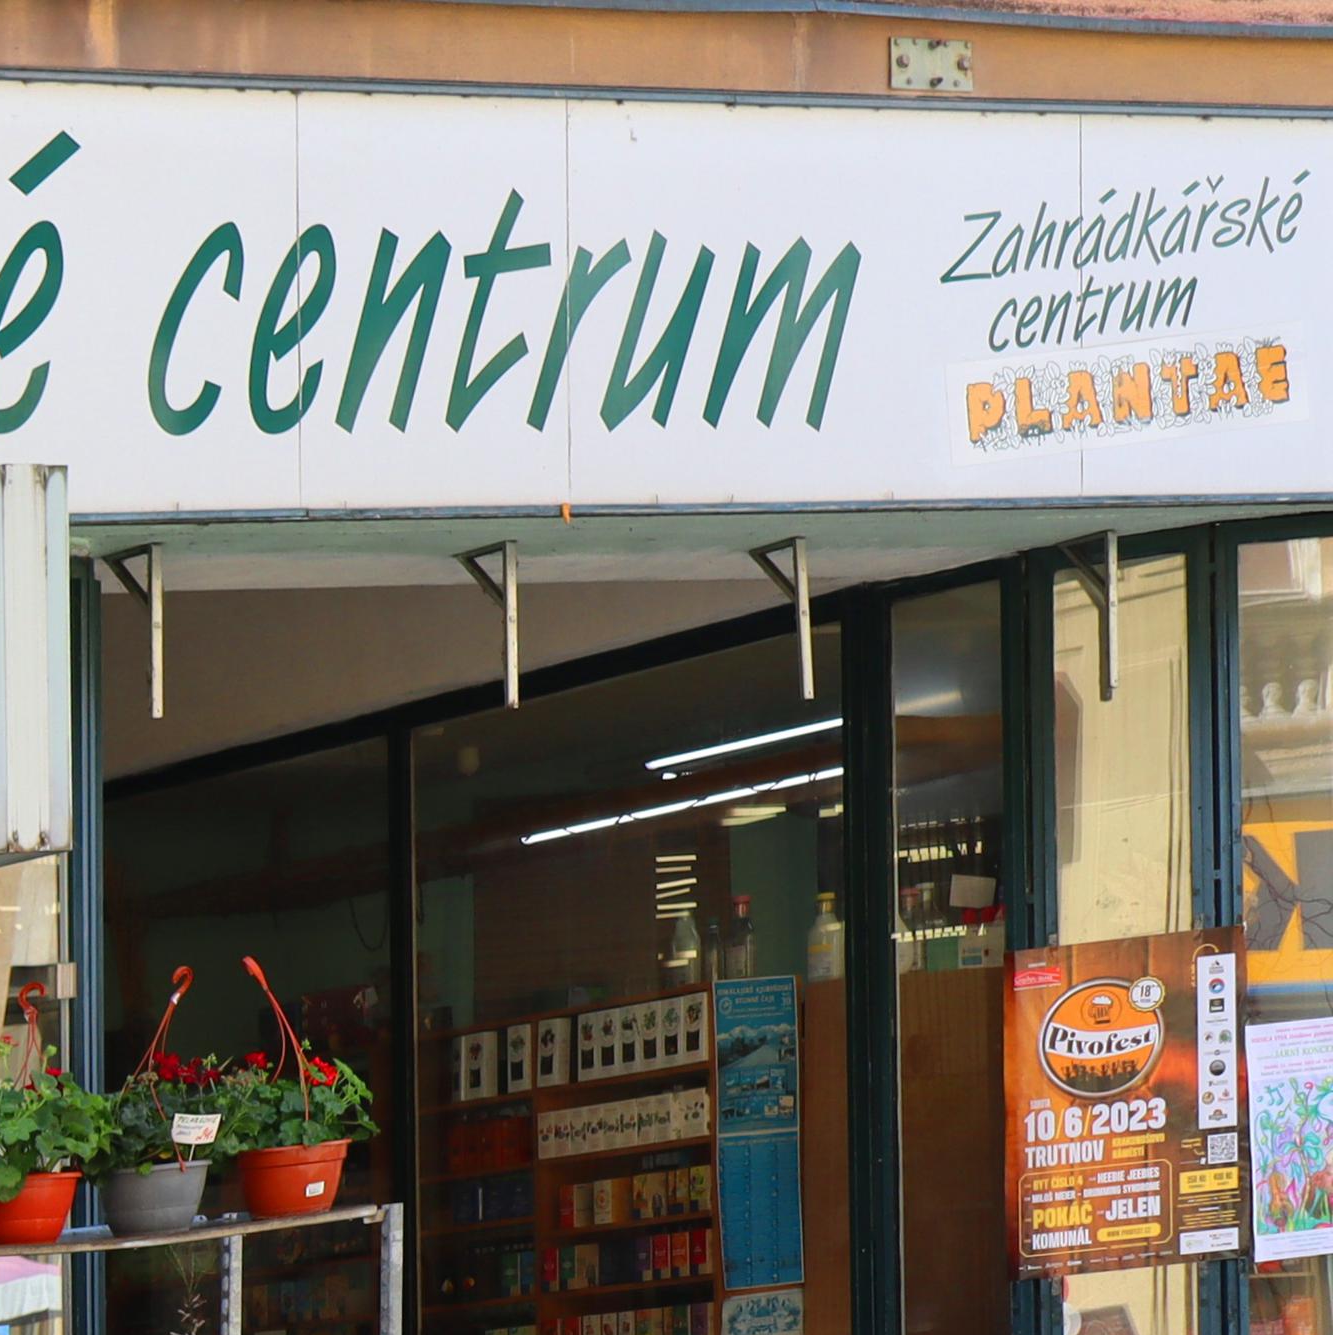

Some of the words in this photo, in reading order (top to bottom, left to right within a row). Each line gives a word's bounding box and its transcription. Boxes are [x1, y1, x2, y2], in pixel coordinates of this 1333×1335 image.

[939, 169, 1311, 284] Zahrádkářské
[147, 187, 863, 436] centrum
[988, 275, 1198, 353] centrum
[966, 344, 1290, 443] PLANTAE
[1047, 1024, 1153, 1057] Pivofest
[1023, 1096, 1167, 1143] 10/6/2023
[1024, 1139, 1105, 1169] TRUTNOV
[1033, 1200, 1093, 1230] POKÁČ
[1105, 1194, 1161, 1222] JELEN
[1032, 1225, 1093, 1251] KOMUNÁL
